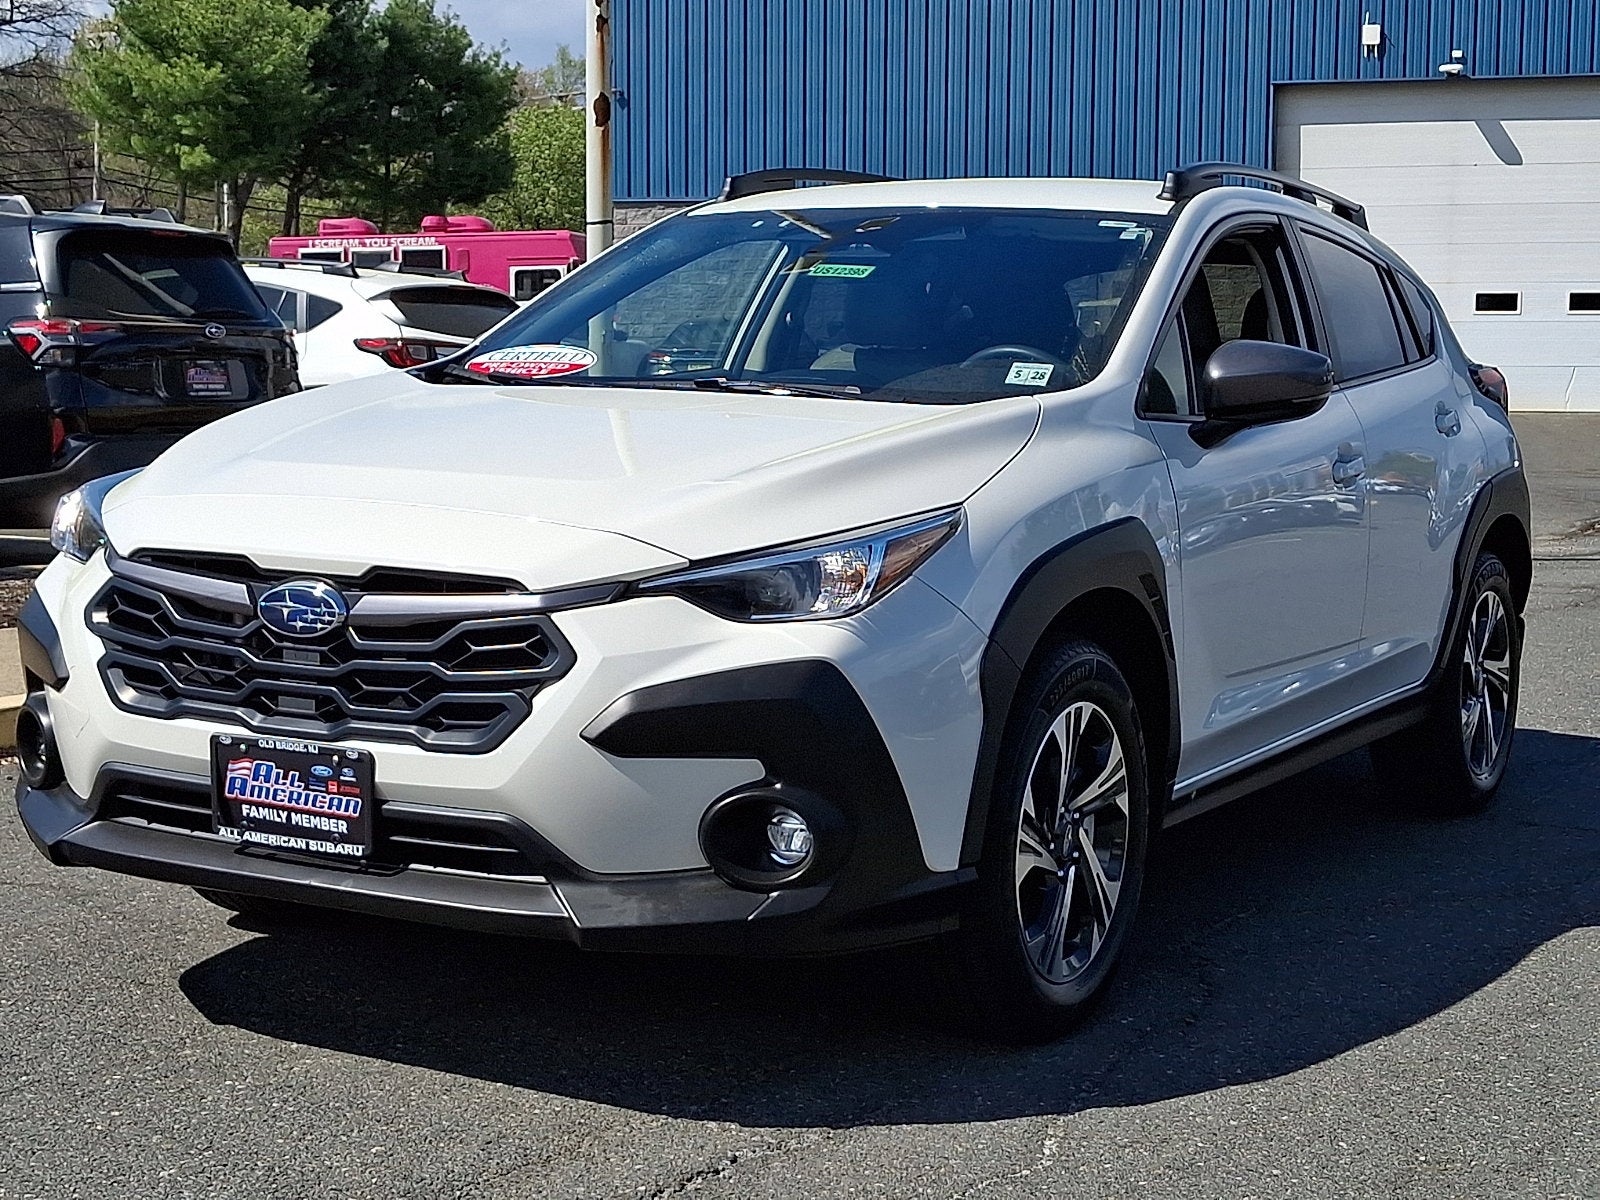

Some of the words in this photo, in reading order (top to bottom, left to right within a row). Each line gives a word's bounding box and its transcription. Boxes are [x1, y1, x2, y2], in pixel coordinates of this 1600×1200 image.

[308, 239, 313, 248] I
[365, 238, 388, 247] YOU
[489, 351, 586, 363] CERTIFIED
[480, 362, 569, 370] PRE-OWNED
[1014, 370, 1023, 379] 5
[1030, 371, 1047, 380] 28
[258, 739, 274, 749] OLD
[308, 745, 319, 754] NJ
[242, 804, 287, 824] FAMILY
[291, 812, 348, 834] MEMBER
[218, 826, 241, 842] ALL
[242, 831, 307, 850] AMERICAN
[308, 841, 365, 856] SUBARU
